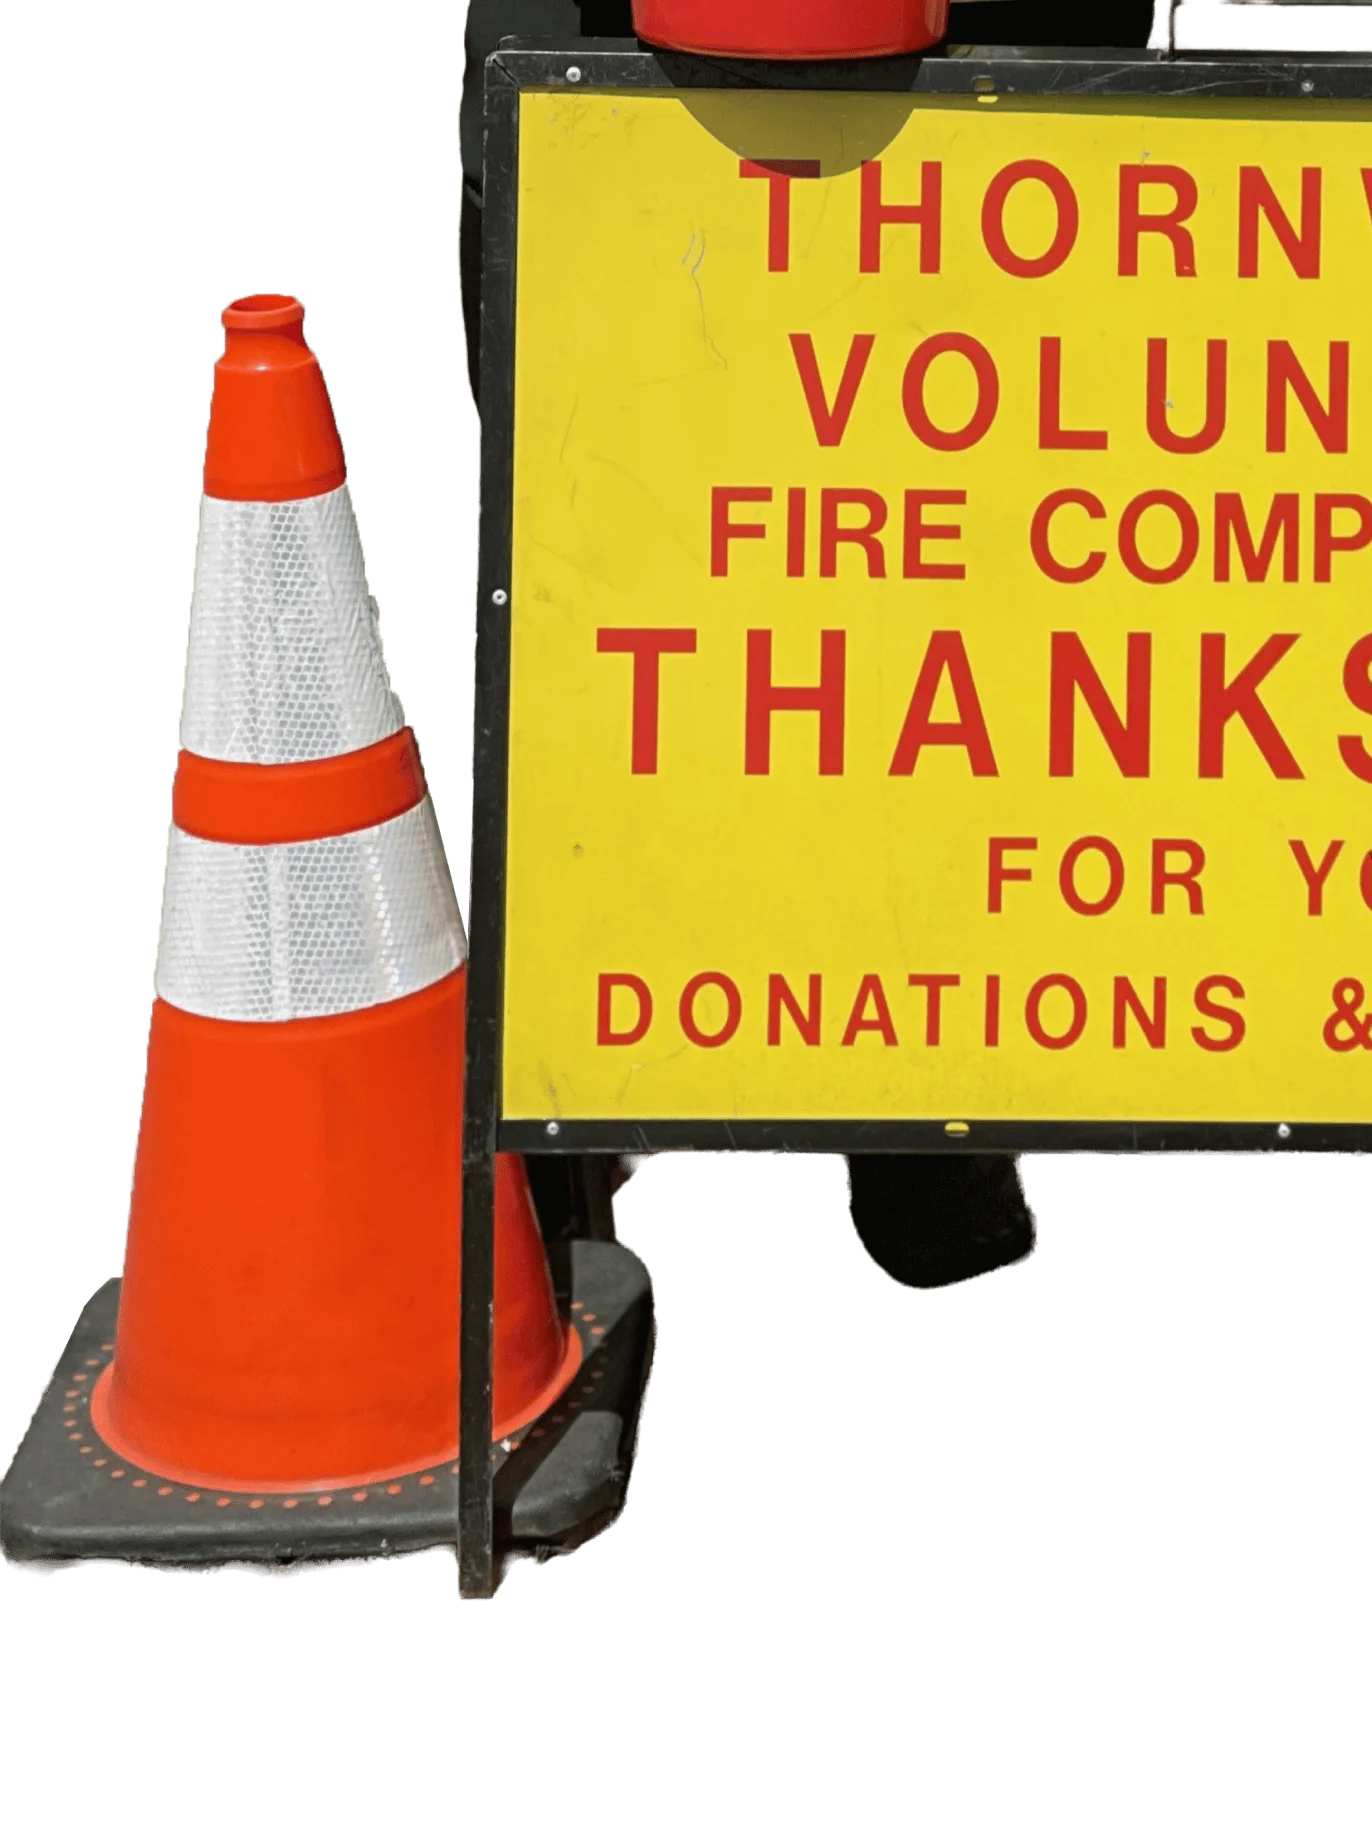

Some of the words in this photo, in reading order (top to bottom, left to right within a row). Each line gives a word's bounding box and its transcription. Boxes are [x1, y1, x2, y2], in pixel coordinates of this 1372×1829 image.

[710, 486, 967, 580] FIRE
[987, 836, 1206, 916] FOR
[596, 972, 1247, 1052] DONATIONS
